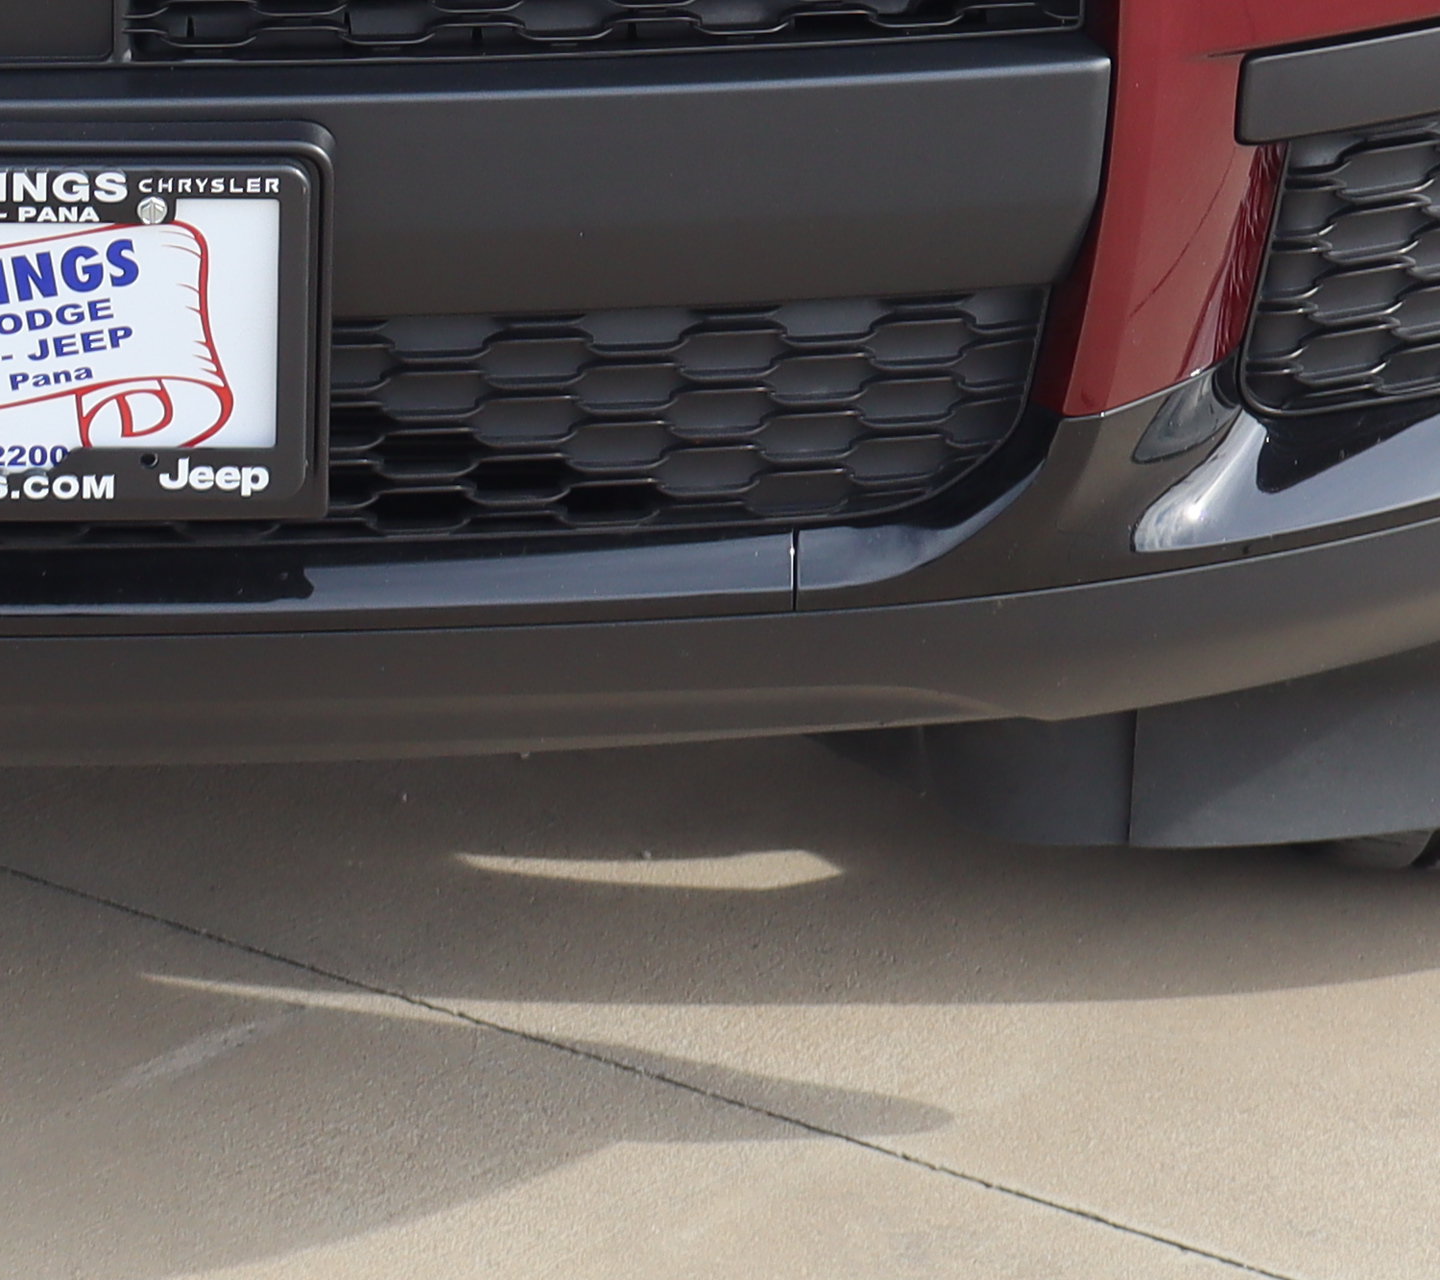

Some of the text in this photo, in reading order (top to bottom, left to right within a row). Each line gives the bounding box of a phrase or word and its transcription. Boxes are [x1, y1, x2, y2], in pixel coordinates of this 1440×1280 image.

[138, 177, 280, 193] CHRYSLER
[18, 206, 100, 222] PANA
[27, 326, 133, 361] JEEP
[9, 366, 94, 391] Pana
[159, 457, 270, 497] Jeep
